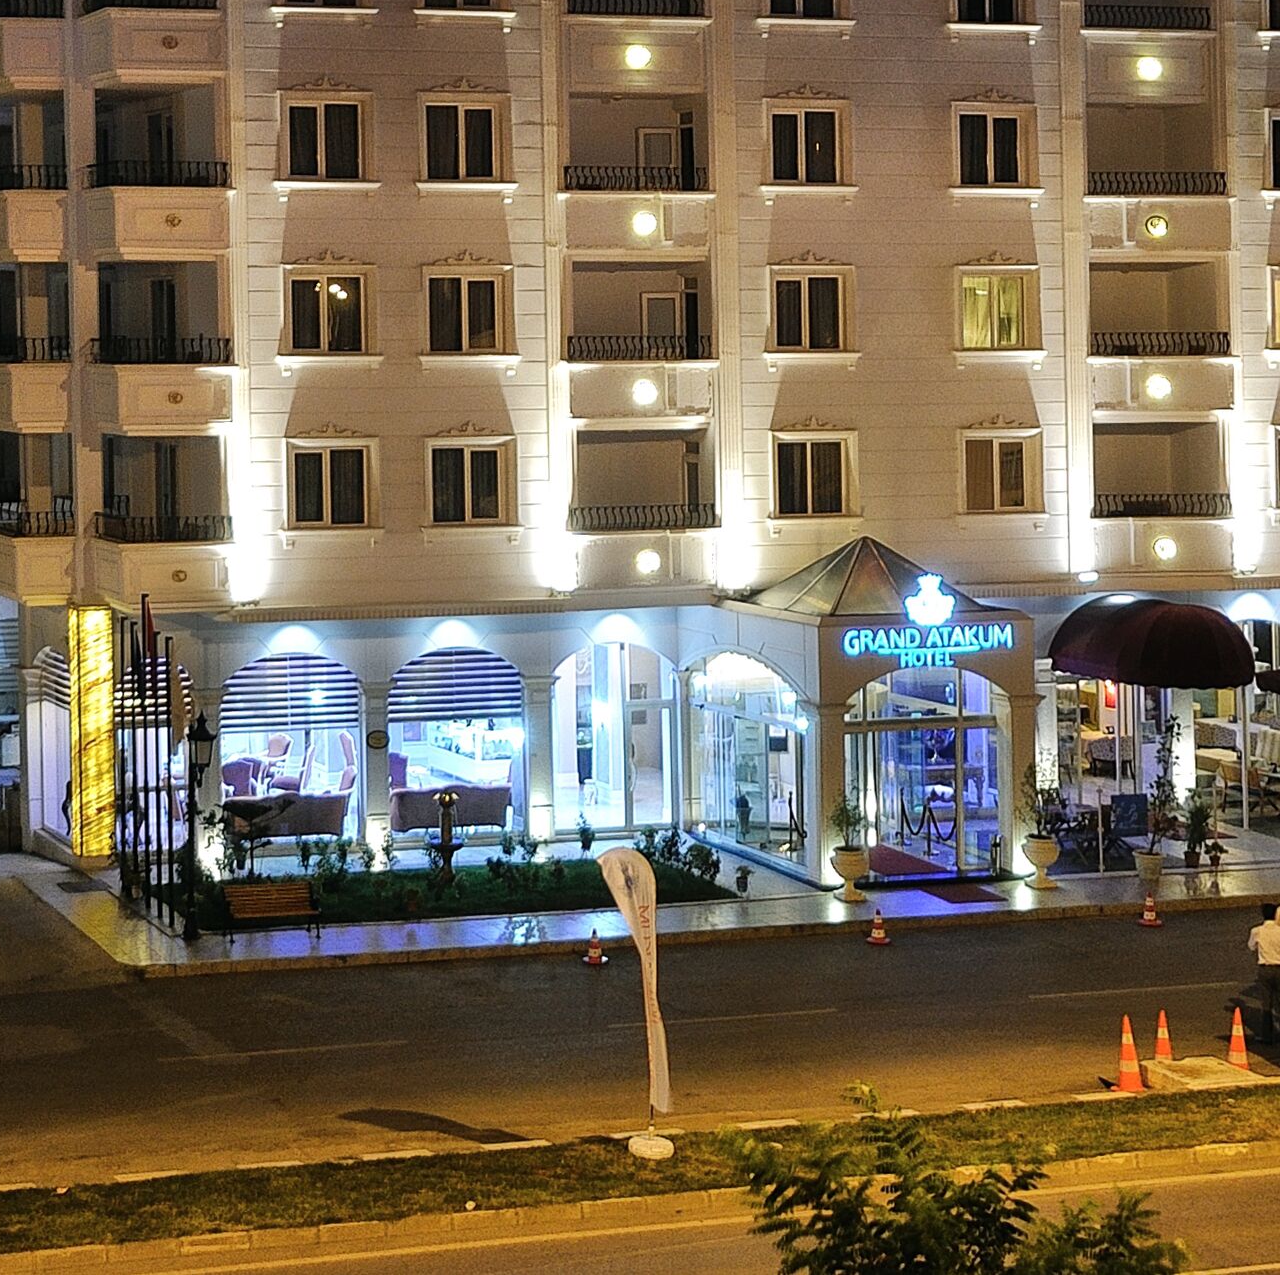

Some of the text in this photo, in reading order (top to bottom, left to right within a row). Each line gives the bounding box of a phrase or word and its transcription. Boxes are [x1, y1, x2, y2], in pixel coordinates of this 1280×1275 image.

[843, 624, 1014, 656] GRAND ATAKUM
[900, 651, 955, 668] HOTEL
